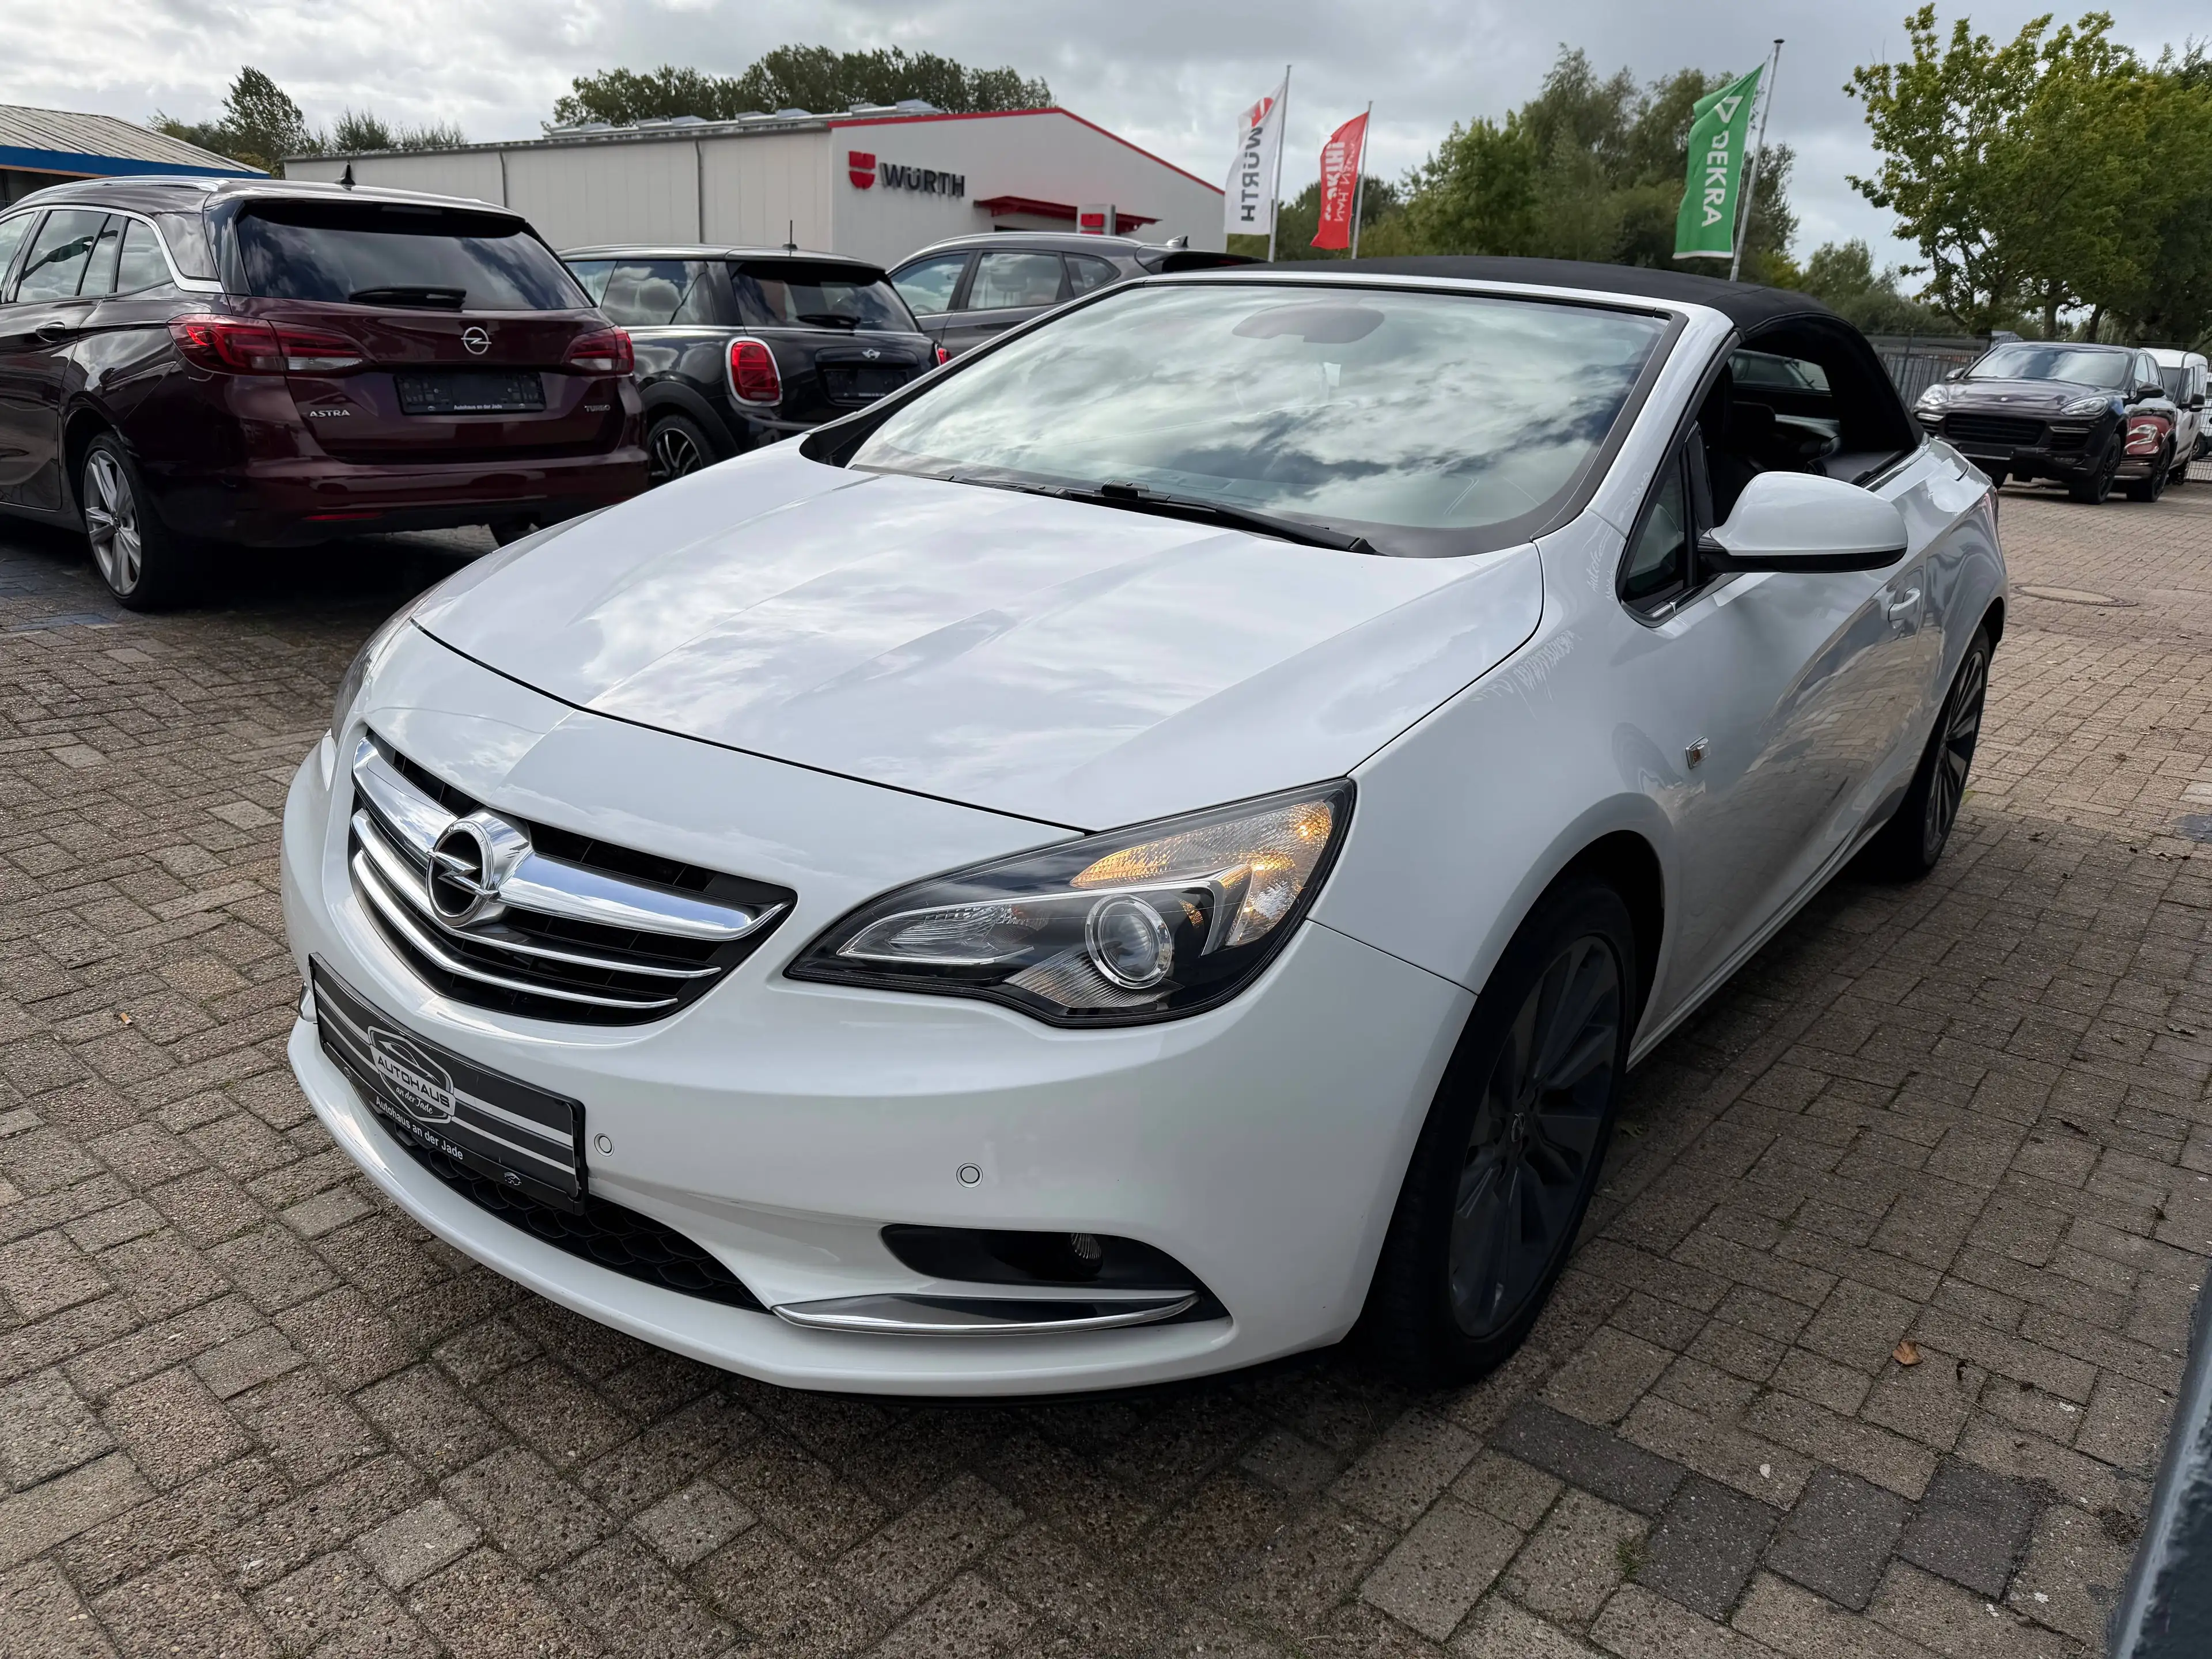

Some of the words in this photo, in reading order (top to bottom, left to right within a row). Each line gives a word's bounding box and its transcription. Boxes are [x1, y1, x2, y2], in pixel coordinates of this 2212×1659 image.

[880, 162, 965, 197] WÜRTH
[1701, 130, 1728, 228] DEKRA
[310, 410, 350, 418] ASTRA
[377, 1056, 450, 1108] AUTOHAUS
[396, 1086, 404, 1097] an
[404, 1091, 416, 1104] der
[415, 1098, 434, 1115] Jade
[376, 1095, 411, 1129] Autohaus
[412, 1123, 423, 1138] an
[425, 1131, 440, 1146] der
[441, 1139, 463, 1160] Jade
